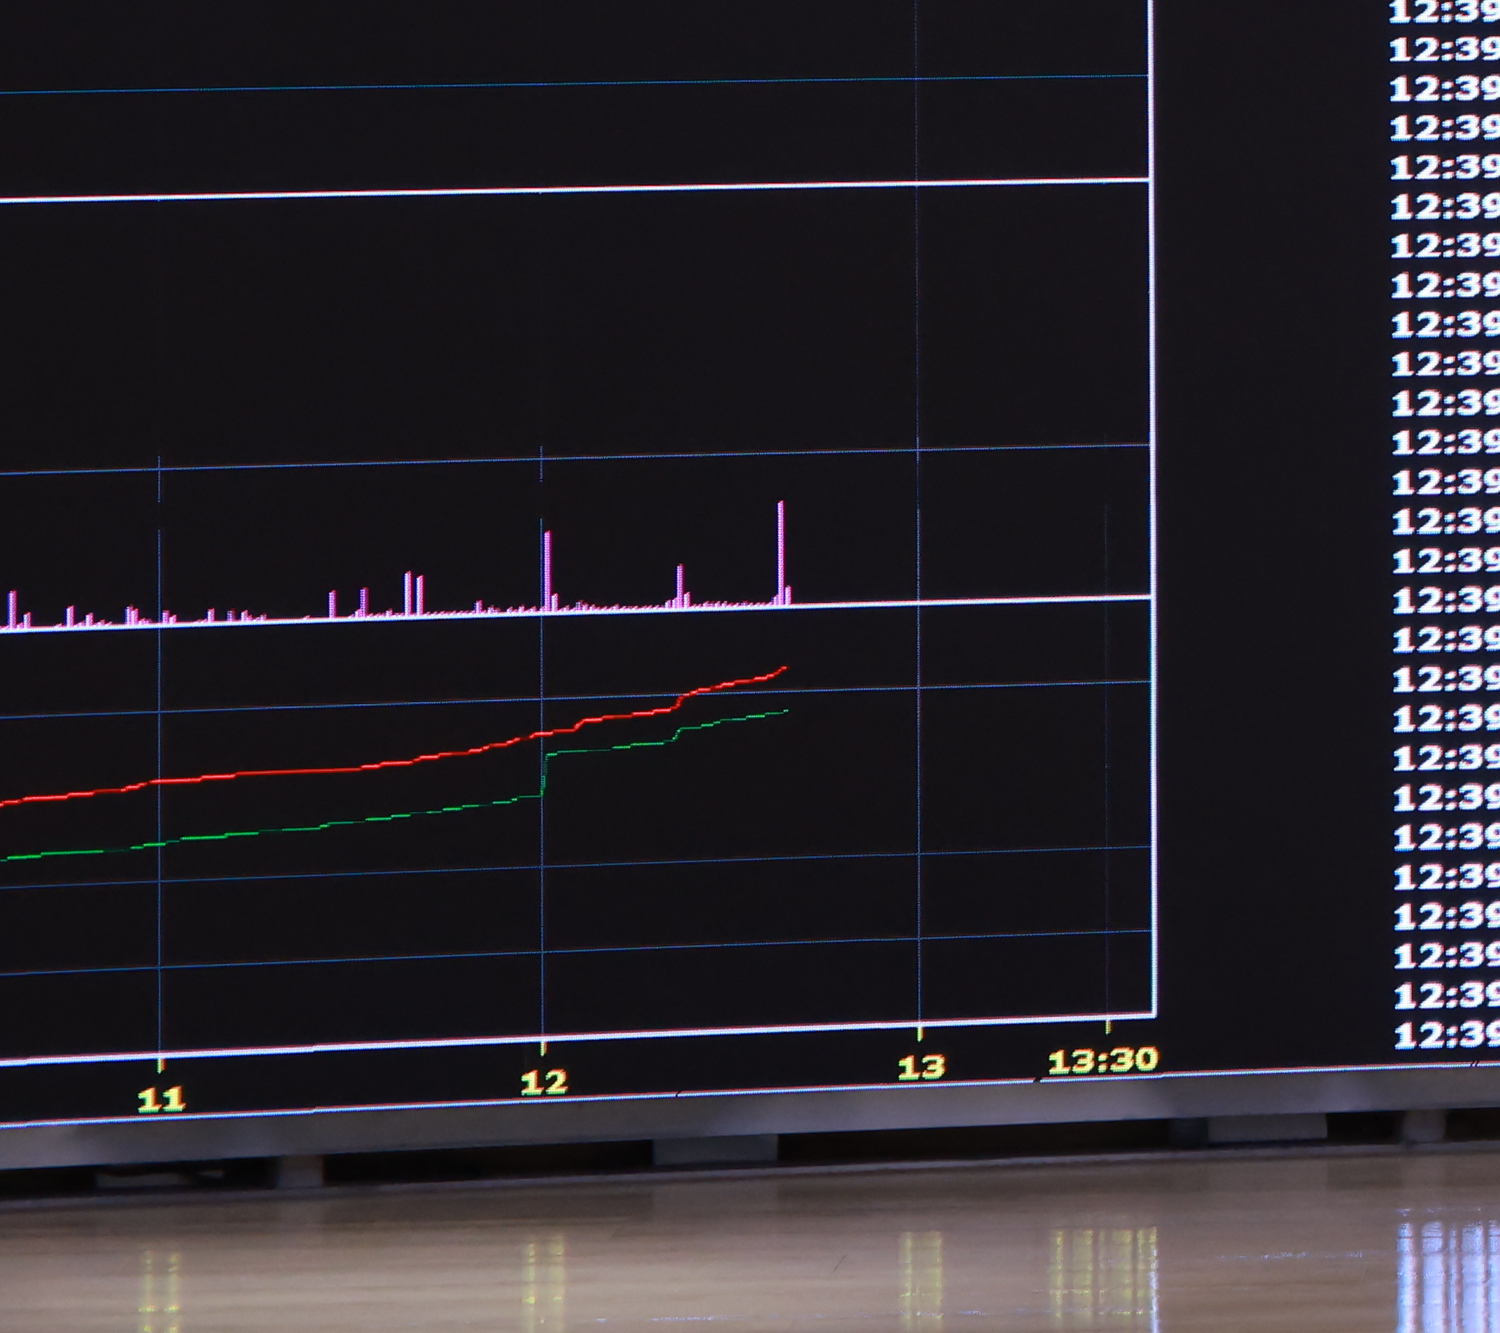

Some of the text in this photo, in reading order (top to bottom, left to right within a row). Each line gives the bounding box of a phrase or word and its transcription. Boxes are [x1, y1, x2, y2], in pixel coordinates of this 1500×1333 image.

[140, 1048, 1158, 1110] 11 12 13 13:30
